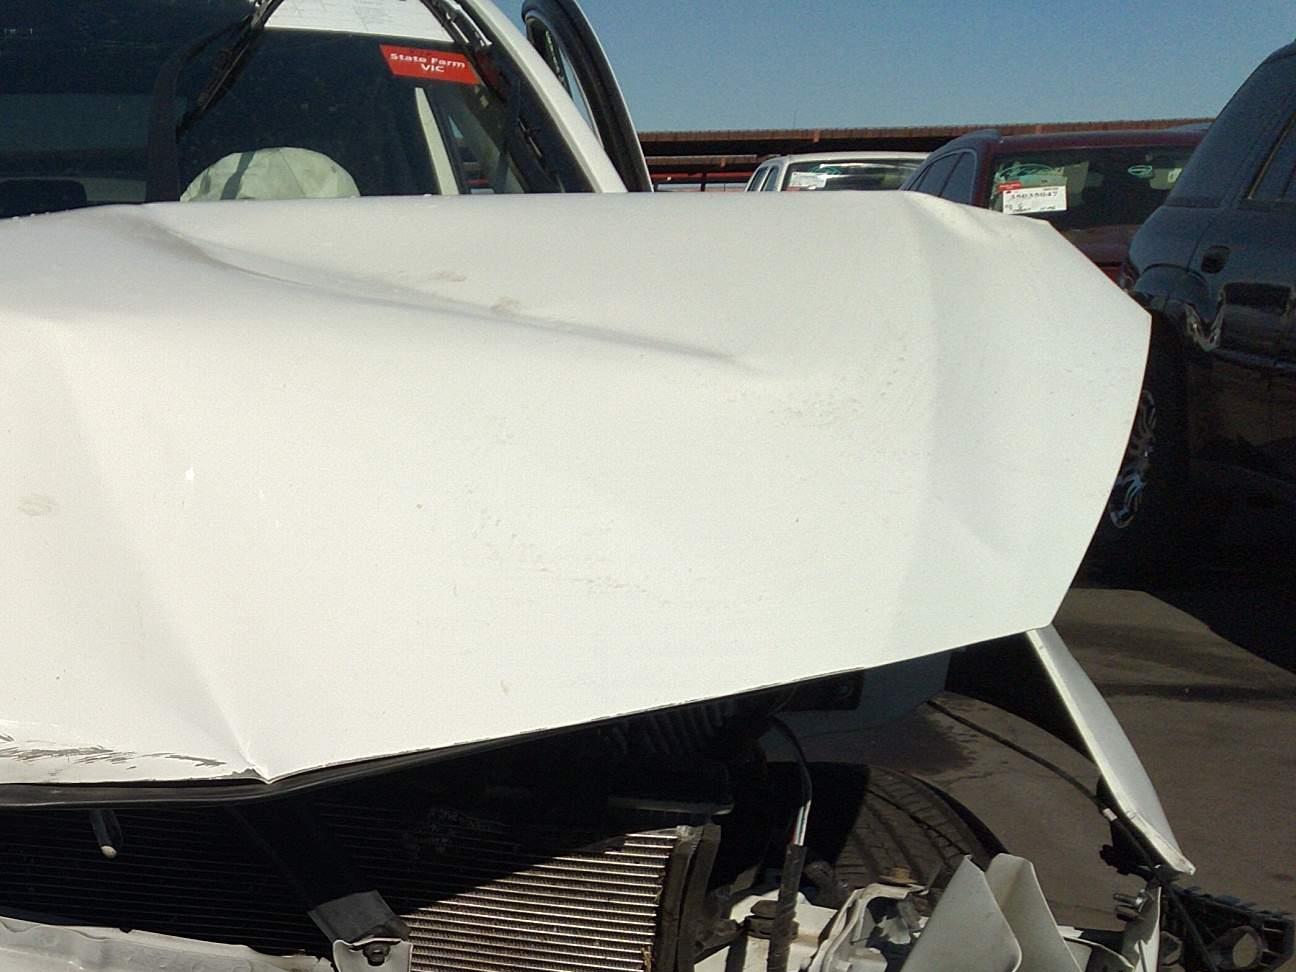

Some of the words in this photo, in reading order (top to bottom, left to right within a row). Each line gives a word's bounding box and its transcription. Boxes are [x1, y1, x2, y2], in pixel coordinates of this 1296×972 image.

[390, 53, 428, 64] State
[431, 57, 466, 68] Farm
[420, 63, 445, 73] VIC
